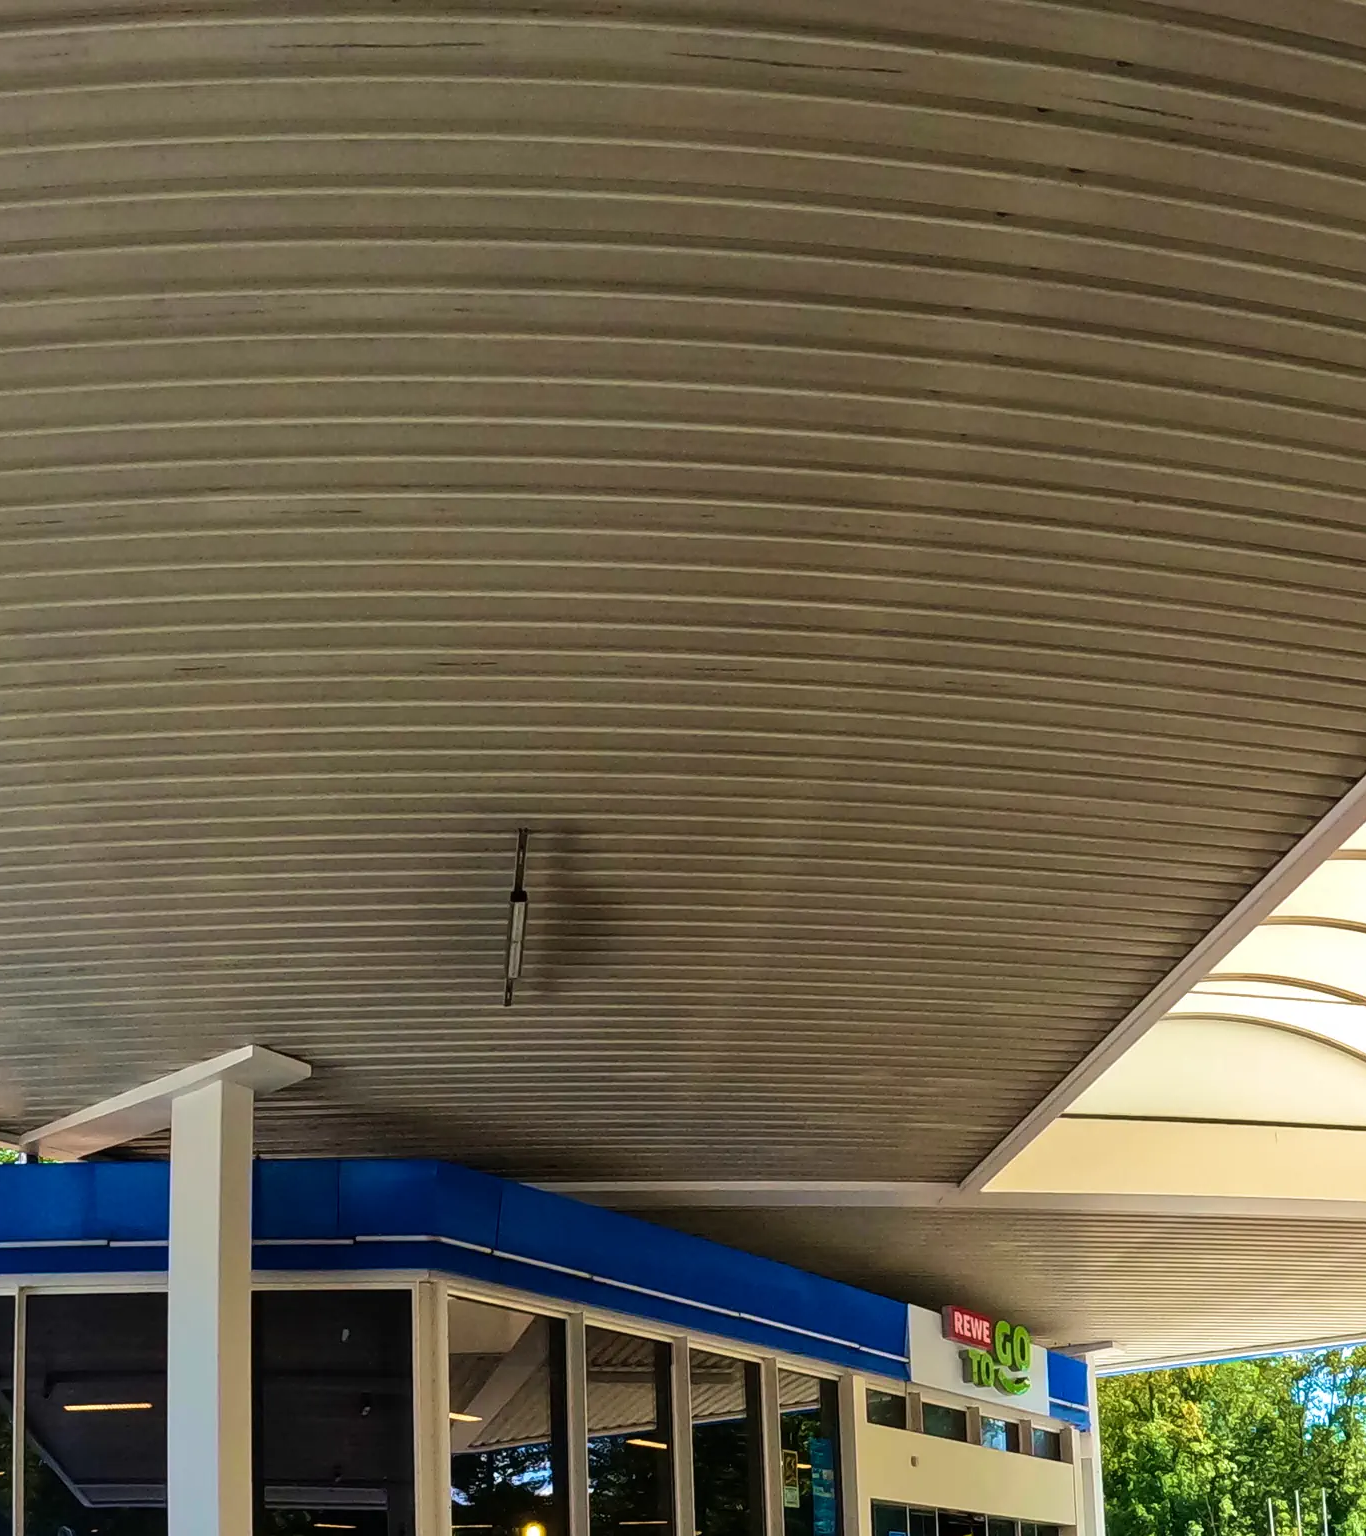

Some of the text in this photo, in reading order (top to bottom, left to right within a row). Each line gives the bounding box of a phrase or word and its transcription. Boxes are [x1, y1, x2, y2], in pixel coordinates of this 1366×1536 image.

[954, 1311, 991, 1344] REWE
[968, 1320, 1031, 1387] TO GO
